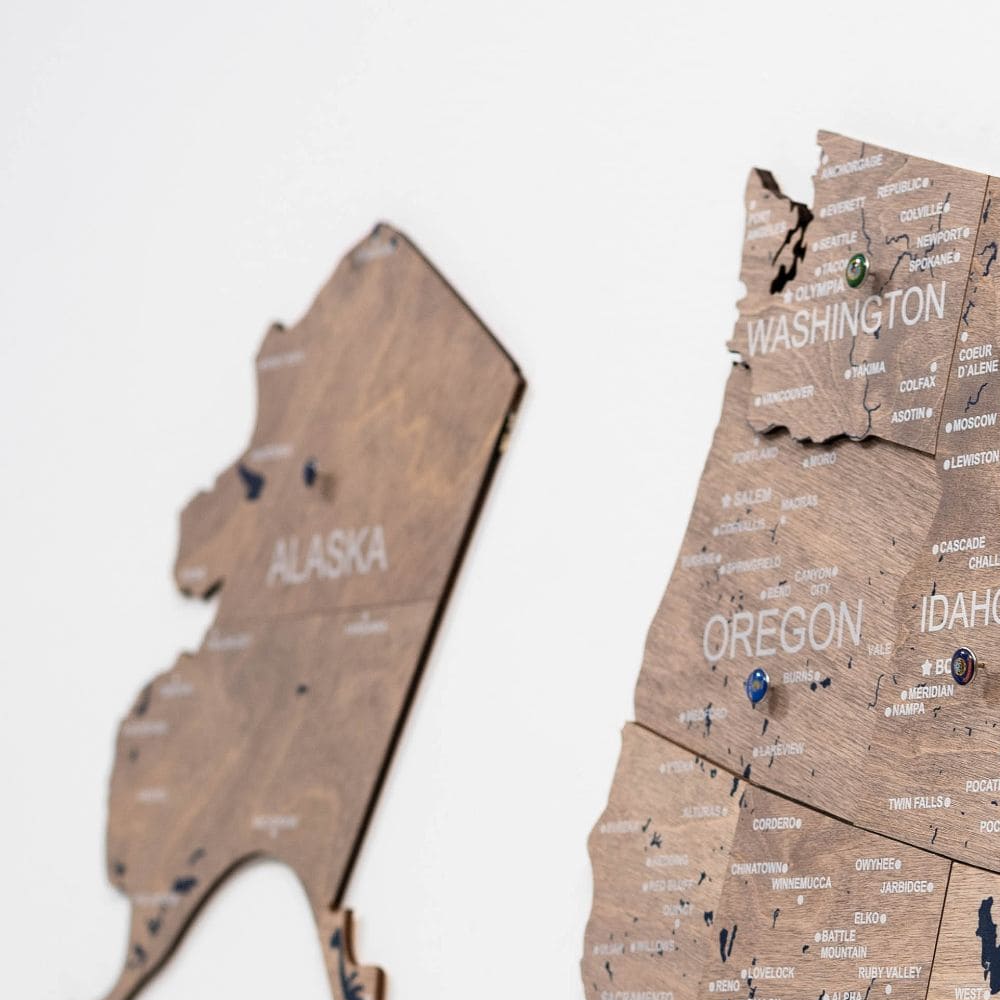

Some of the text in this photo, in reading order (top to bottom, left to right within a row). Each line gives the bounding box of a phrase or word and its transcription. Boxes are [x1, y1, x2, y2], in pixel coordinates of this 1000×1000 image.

[877, 178, 922, 198] REPUBLIC
[900, 202, 943, 222] COLVILLE
[917, 228, 963, 248] NEWPORT
[909, 253, 954, 272] SPOKANE
[747, 281, 947, 356] WASHINGTON
[959, 345, 992, 362] COEUR
[899, 376, 937, 393] COLFAX
[891, 407, 926, 423] ASOTIN
[953, 413, 997, 432] MOSCOW
[809, 452, 837, 466] MORO
[951, 450, 999, 468] LEWISTON
[939, 537, 986, 553] CASCADE
[267, 525, 390, 588] ALASKA
[703, 600, 864, 663] OREGON
[908, 685, 954, 699] MERIDIAN
[891, 703, 925, 717] NAMPA
[889, 796, 942, 810] TWIN FALLS
[753, 817, 796, 831] CORDERO
[731, 861, 783, 874] CHINATOWN
[856, 858, 895, 871] OWYHEE
[772, 877, 832, 891] WINNEMUCCA
[880, 881, 927, 893] JARBIDGE
[854, 912, 879, 924] ELKO
[822, 930, 856, 942] BATTLE
[821, 946, 867, 959] MOUNTAIN
[747, 967, 795, 979] LOVELOCK
[859, 967, 921, 979] RUBY VALLEY
[716, 979, 740, 992] RENO
[955, 988, 983, 1000] WEST
